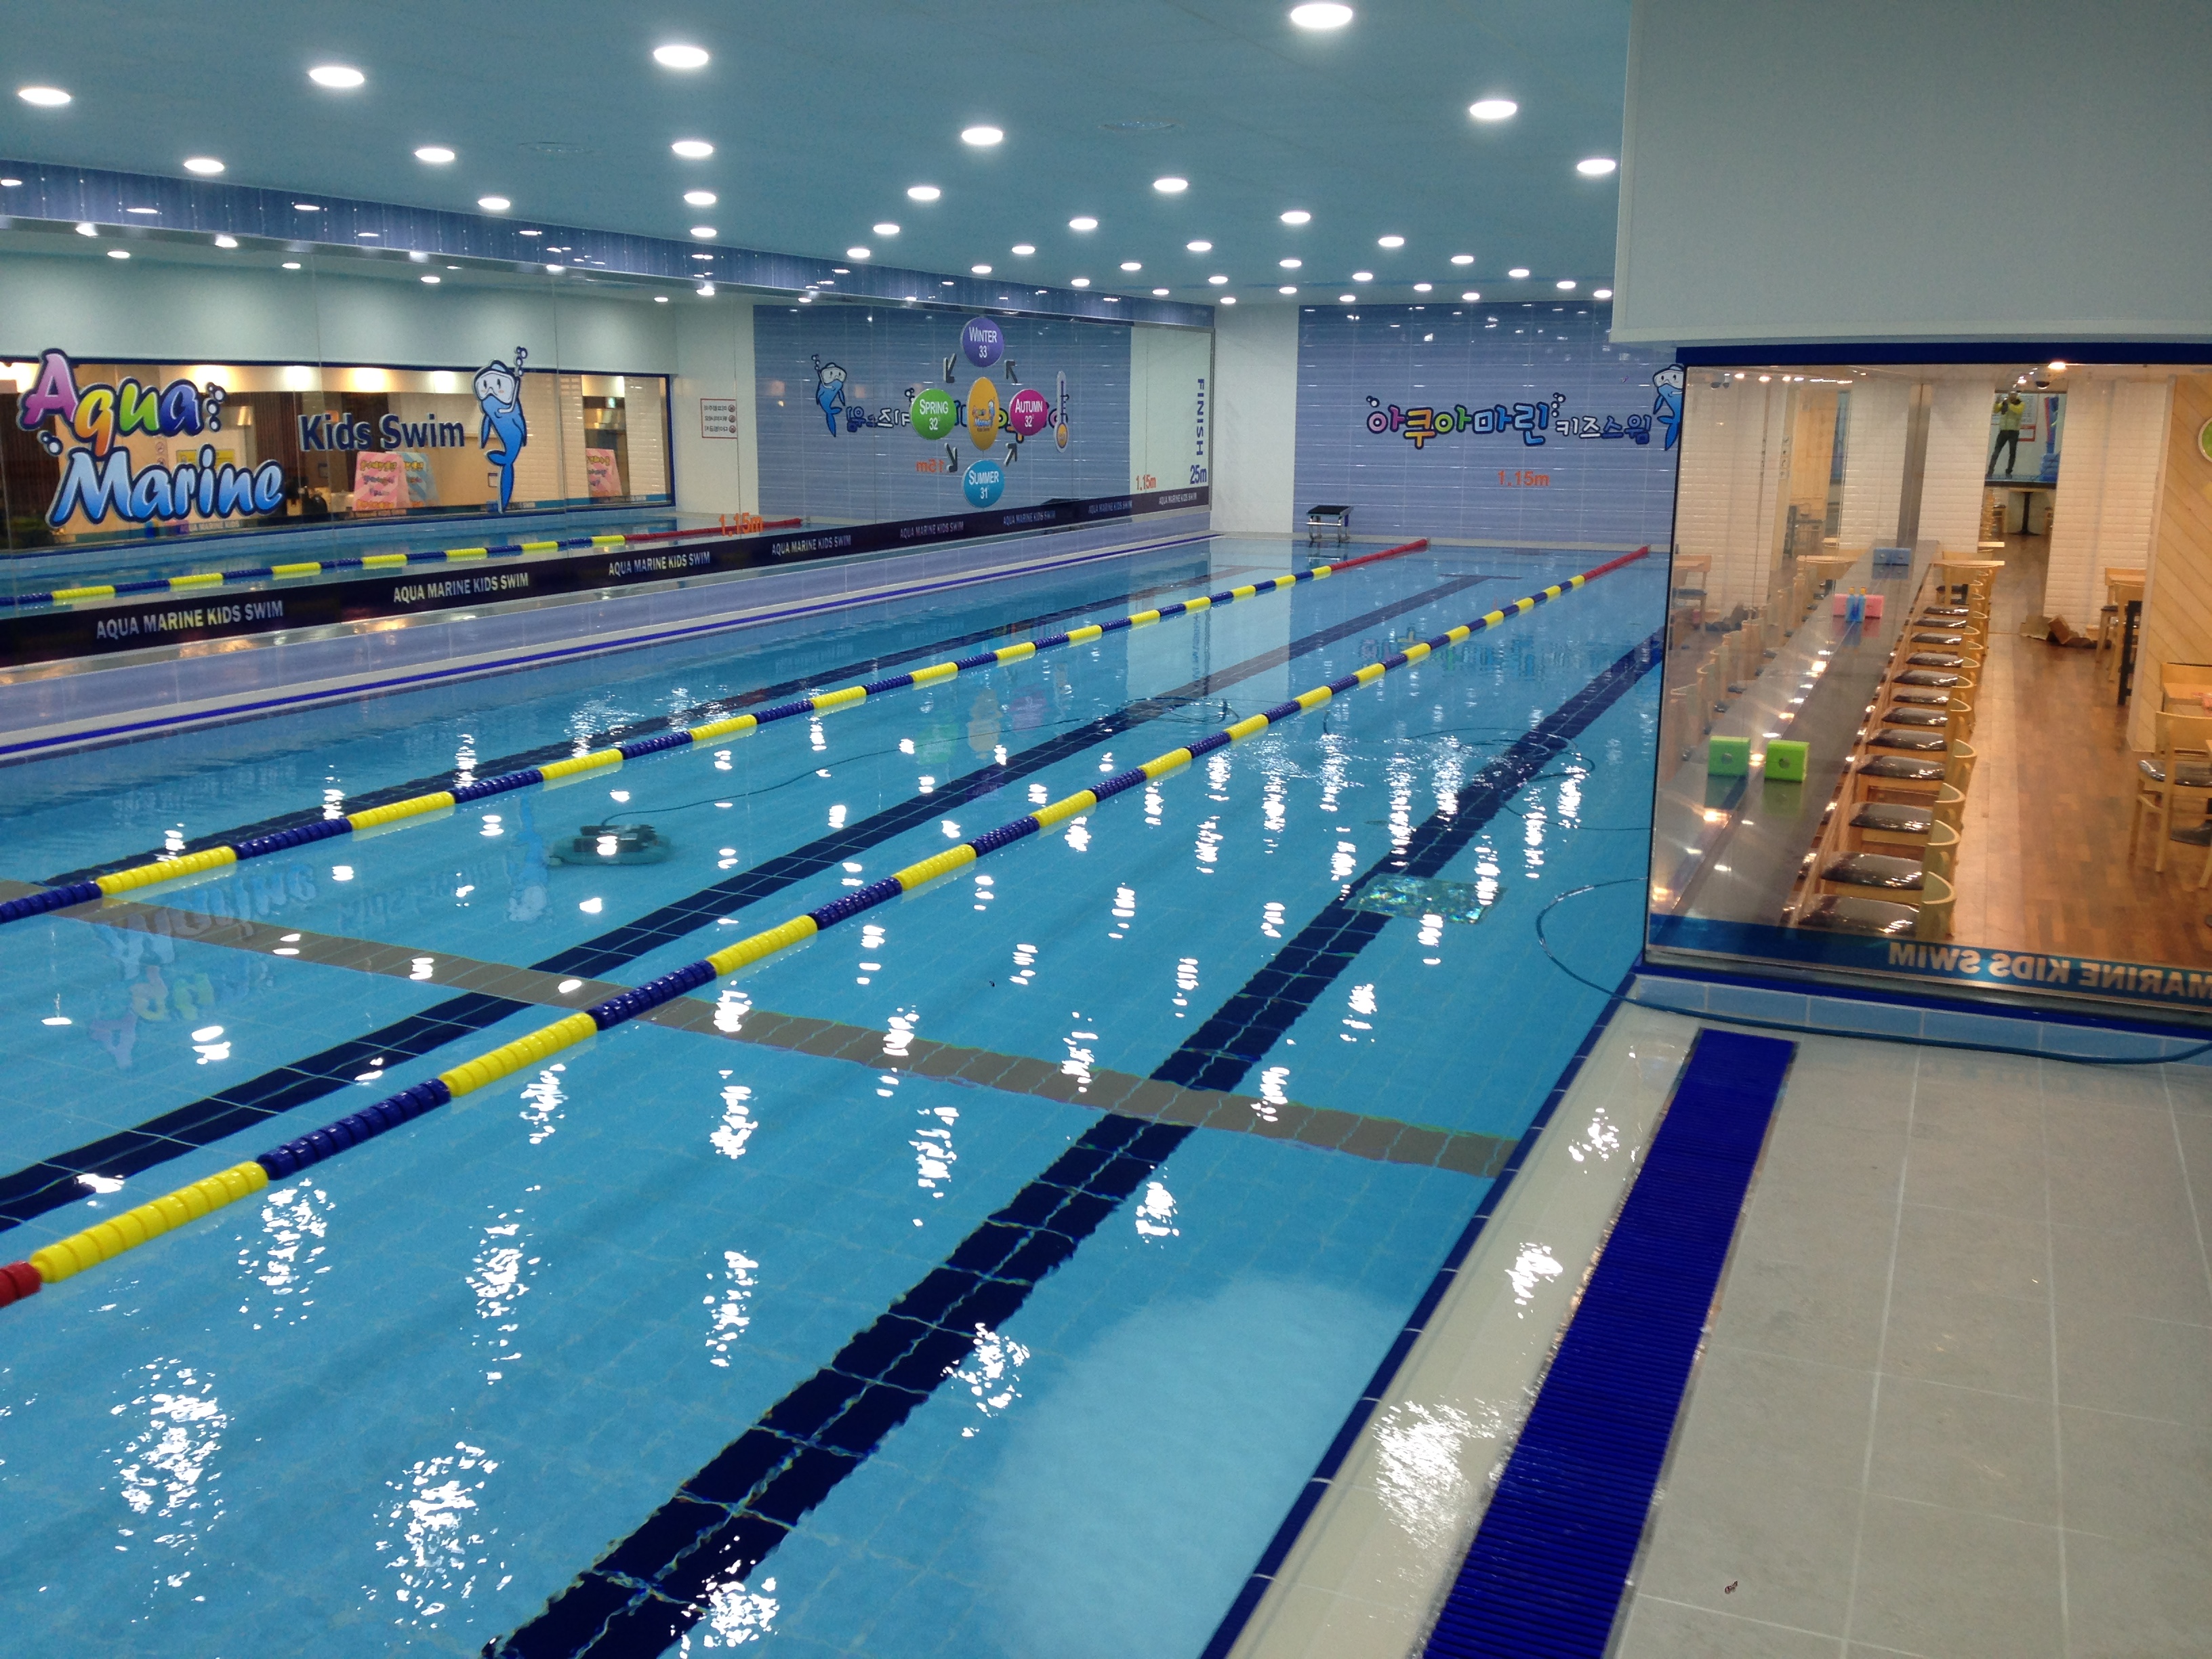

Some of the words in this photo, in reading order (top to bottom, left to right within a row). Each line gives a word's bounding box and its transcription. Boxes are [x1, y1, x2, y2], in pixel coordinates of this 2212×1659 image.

[969, 326, 997, 343] WINTER
[17, 348, 203, 461] Aqua
[920, 398, 948, 415] SPRING
[1015, 398, 1042, 413] AUTUMN
[1196, 379, 1204, 455] FINISH
[1366, 403, 1550, 449] 아쿠아마린
[1556, 414, 1652, 445] 키즈스윔
[298, 412, 372, 451] Kids
[380, 413, 465, 450] Swim
[46, 444, 285, 527] Marine
[968, 470, 999, 485] SUMMER
[1136, 474, 1156, 491] 1.15m
[1189, 464, 1207, 485] 25m
[1498, 470, 1550, 487] 1.15m
[718, 512, 764, 537] 1.15m
[900, 527, 914, 539] AQUA
[916, 524, 936, 537] MARINE
[937, 523, 949, 534] KIDS
[950, 520, 964, 533] SWIM
[1003, 515, 1015, 527] AQUA
[772, 541, 790, 557] AQUA
[791, 538, 817, 554] MARINE
[817, 537, 833, 550] KIDS
[834, 534, 851, 548] SWIM
[609, 560, 632, 577] AQUA
[634, 555, 667, 573] MARINE
[668, 554, 687, 569] KIDS
[689, 551, 710, 566] SWIM
[394, 585, 425, 604] AQUA
[428, 579, 470, 598] MARINE
[474, 576, 498, 593] KIDS
[501, 572, 529, 590] SWIM
[97, 617, 140, 640] AQUA
[143, 609, 203, 633] MARINE
[207, 605, 241, 626] KIDS
[245, 600, 283, 621] SWIM
